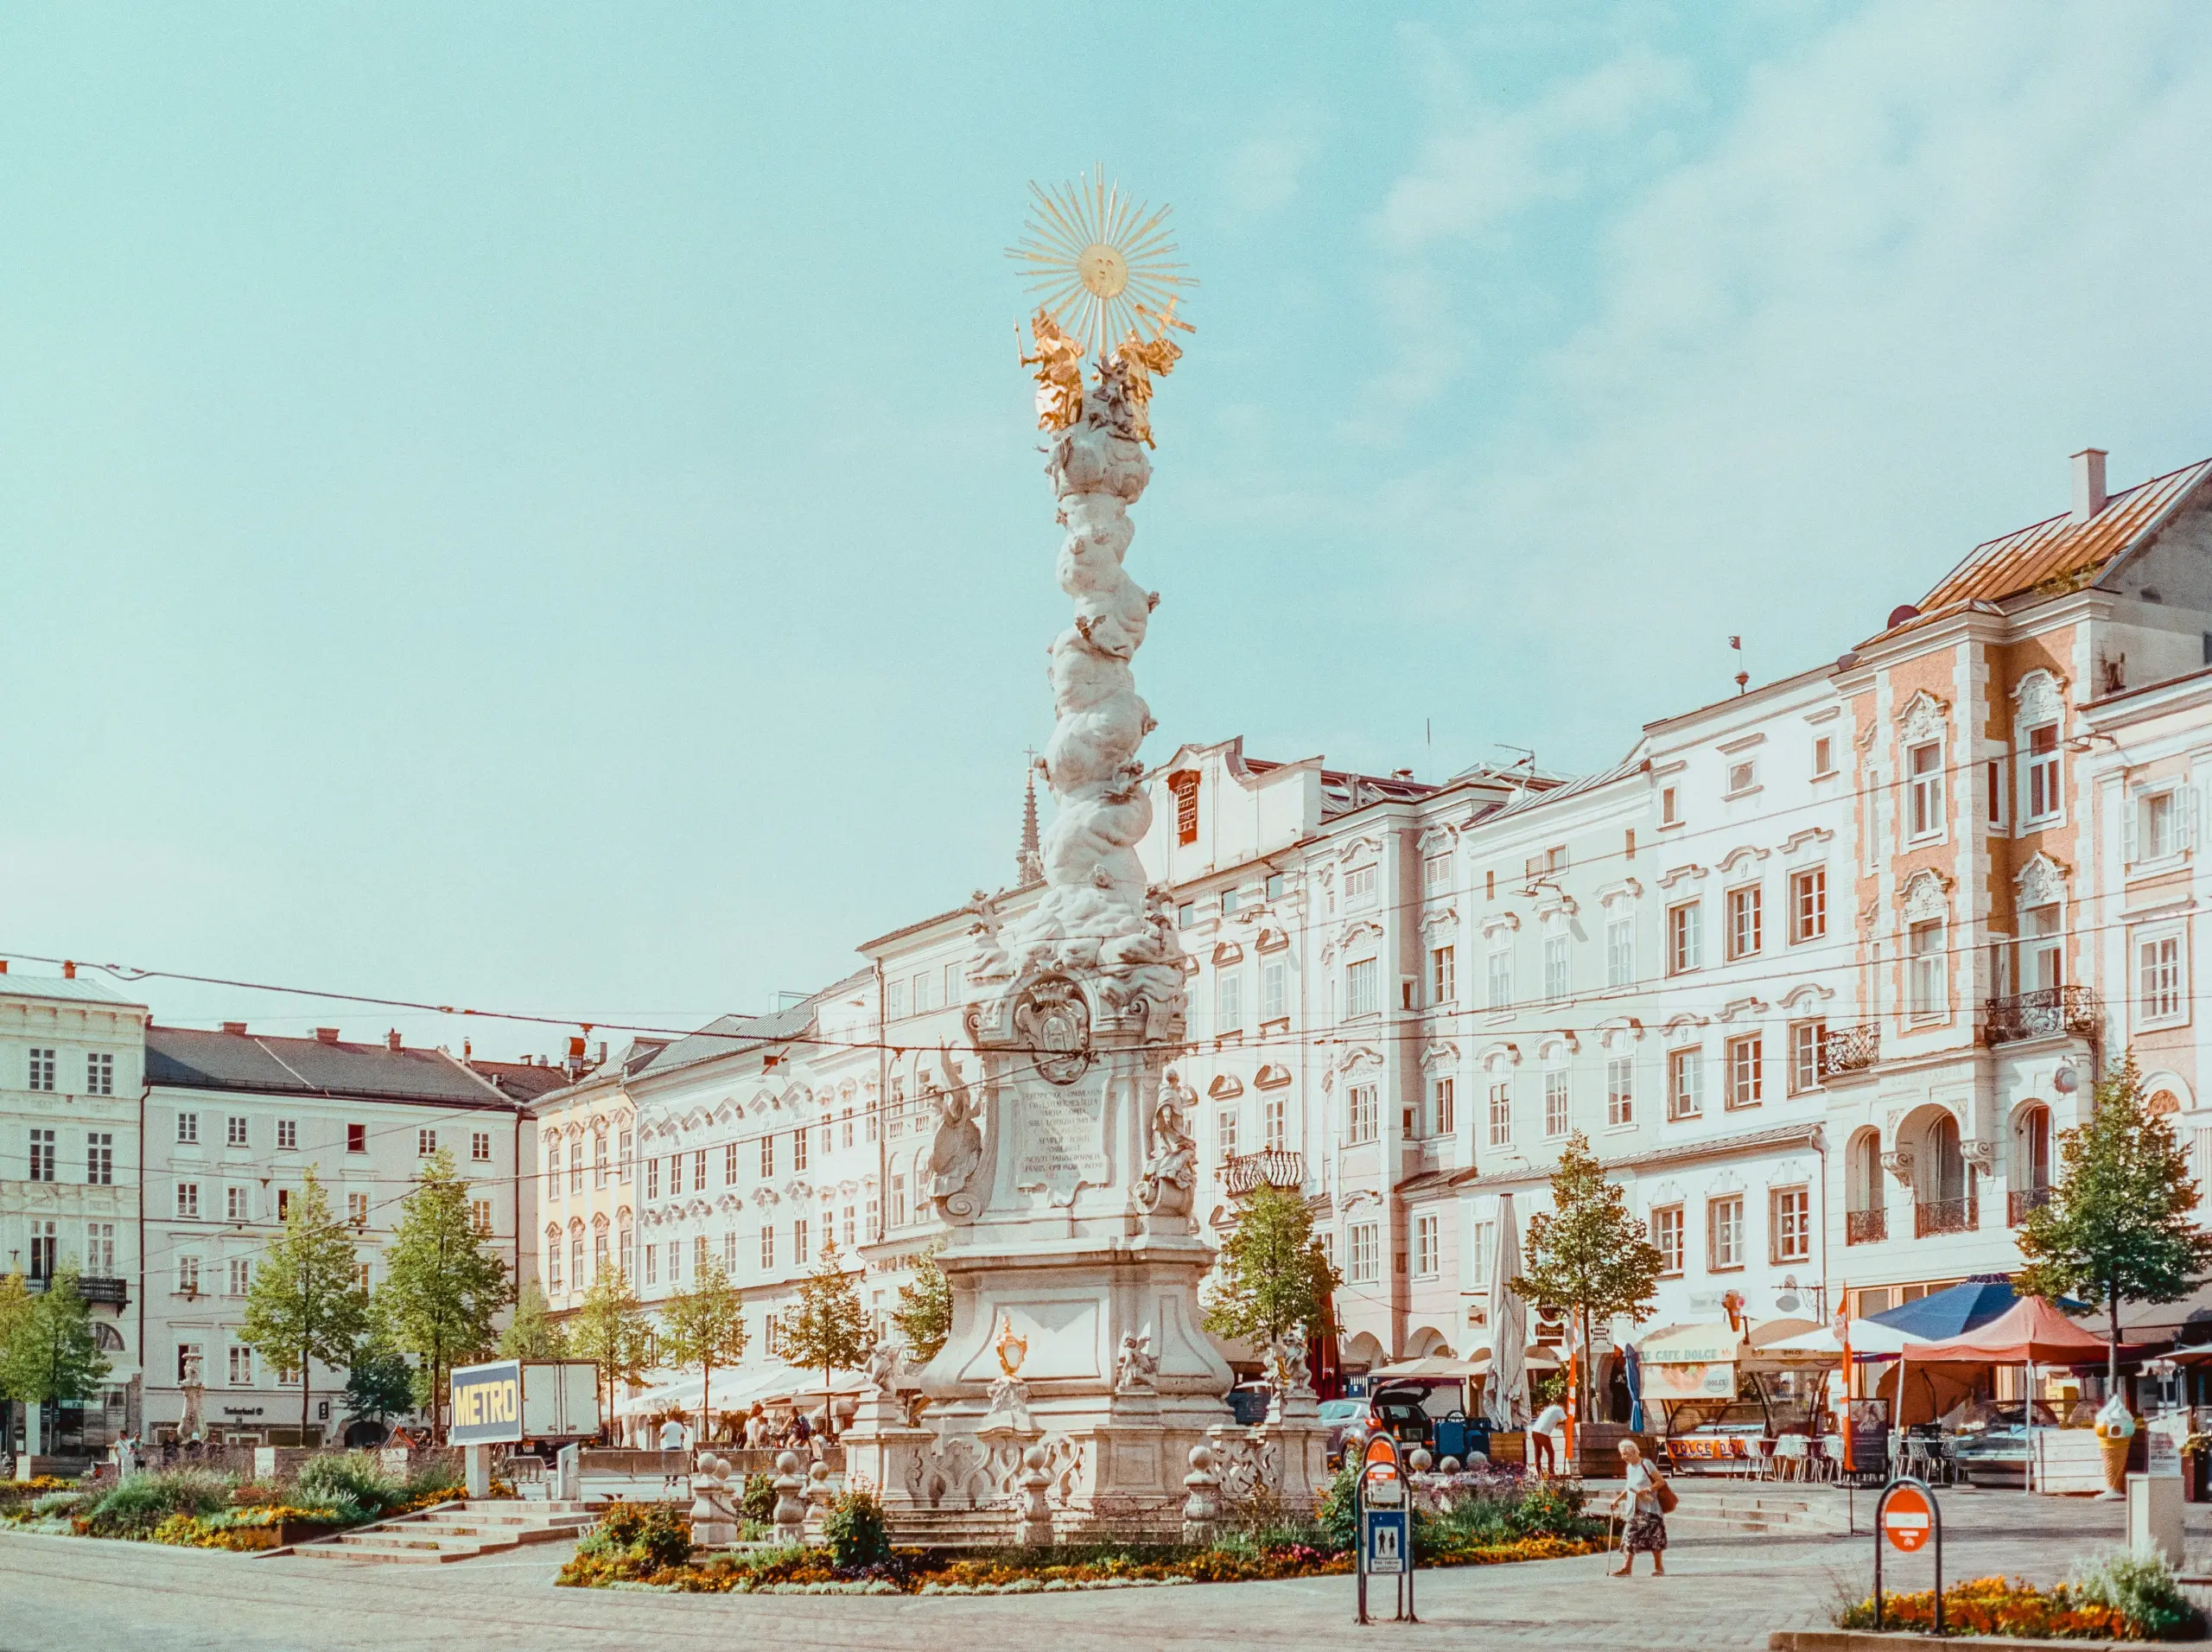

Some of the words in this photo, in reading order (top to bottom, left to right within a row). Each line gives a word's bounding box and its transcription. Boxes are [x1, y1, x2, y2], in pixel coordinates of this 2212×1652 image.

[1685, 1348, 1717, 1360] DOLCE
[454, 1380, 518, 1426] METRO
[1672, 1443, 1712, 1453] DOLCE
